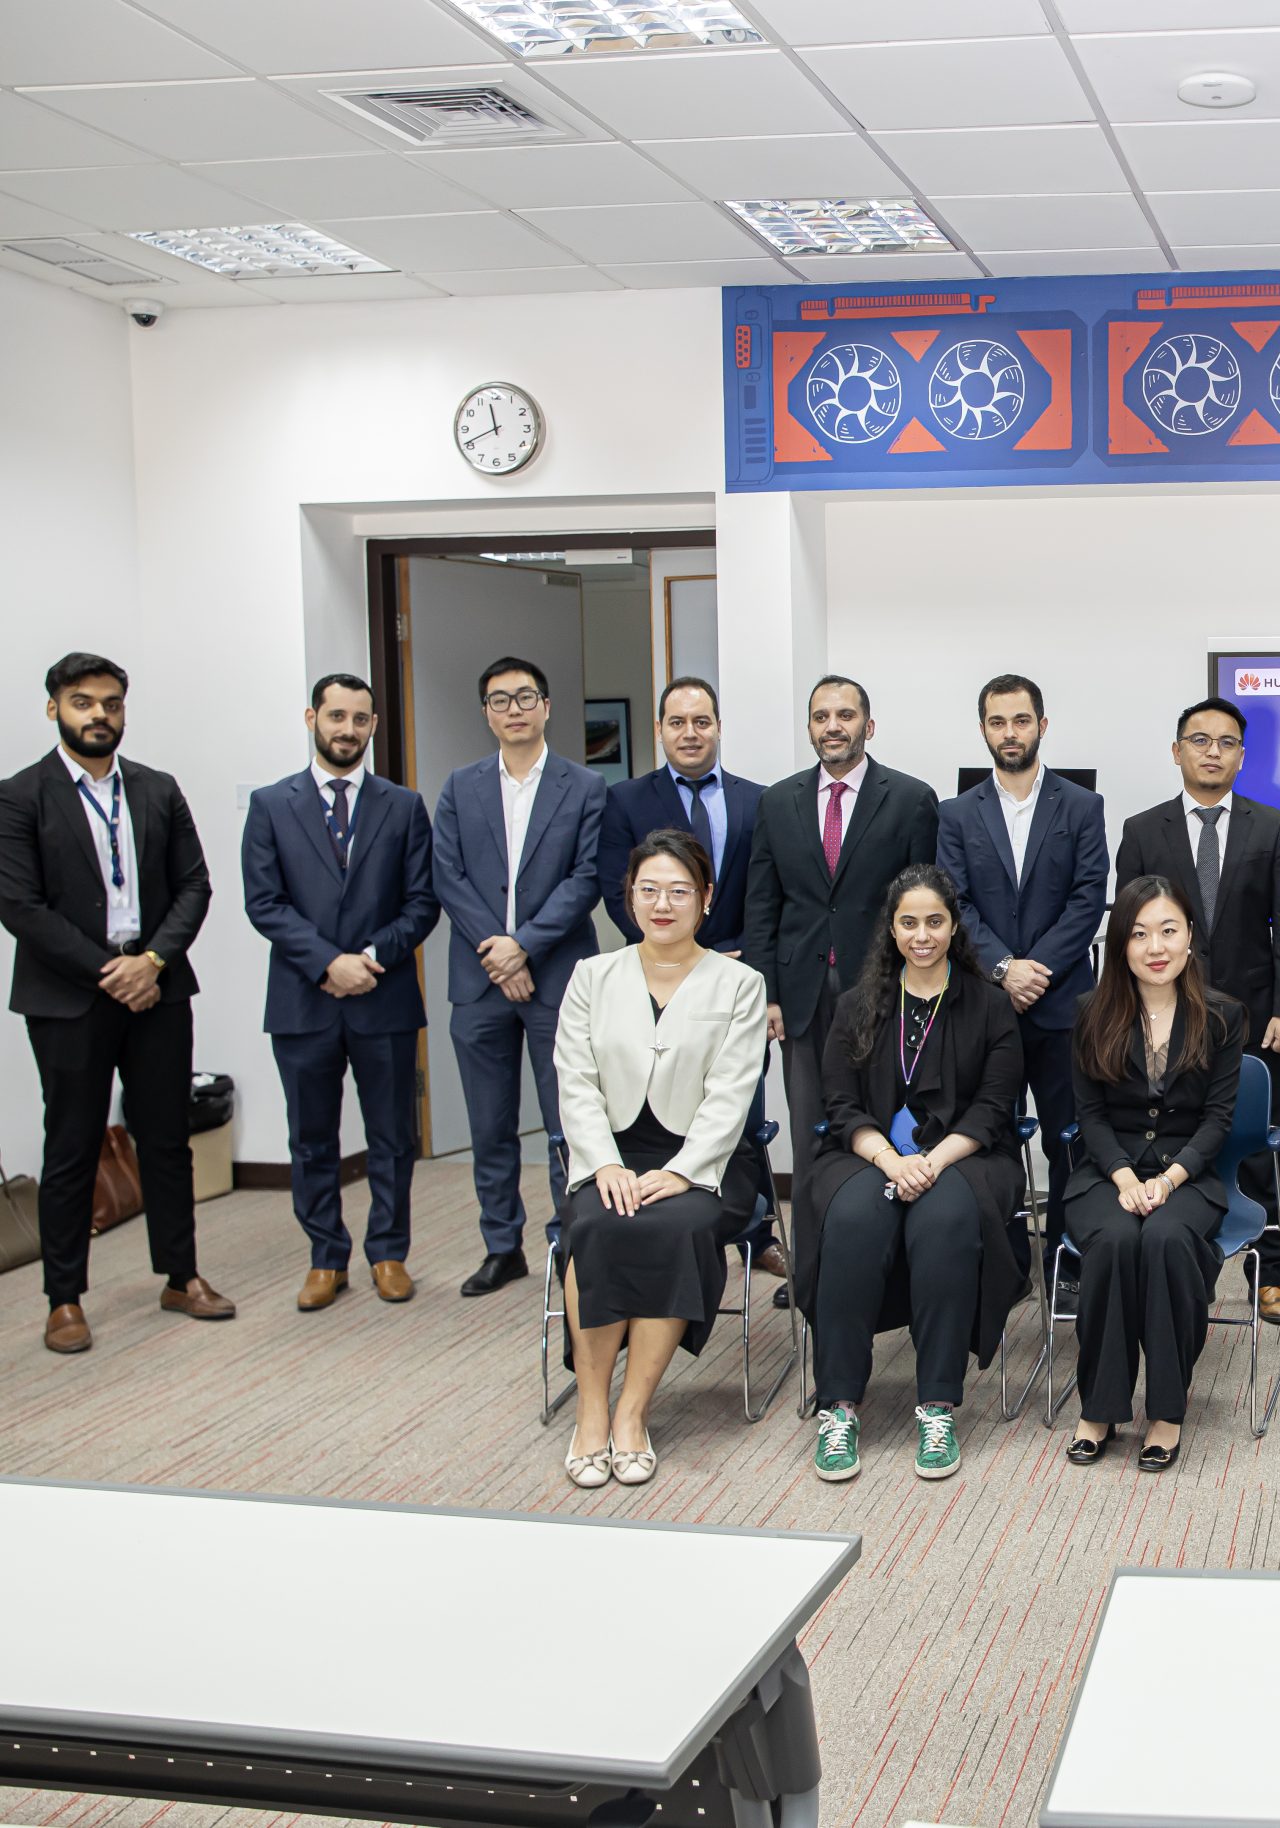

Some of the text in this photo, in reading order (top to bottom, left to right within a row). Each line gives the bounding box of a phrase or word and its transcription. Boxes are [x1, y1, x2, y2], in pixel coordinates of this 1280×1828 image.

[477, 398, 484, 406] 11
[466, 409, 475, 417] 10
[518, 408, 527, 417] 2
[461, 425, 470, 434] 9
[523, 424, 532, 433] 3
[466, 441, 475, 450] 8
[519, 440, 526, 448] 4
[478, 453, 485, 463] 7
[492, 457, 501, 467] 6
[508, 453, 517, 462] 5
